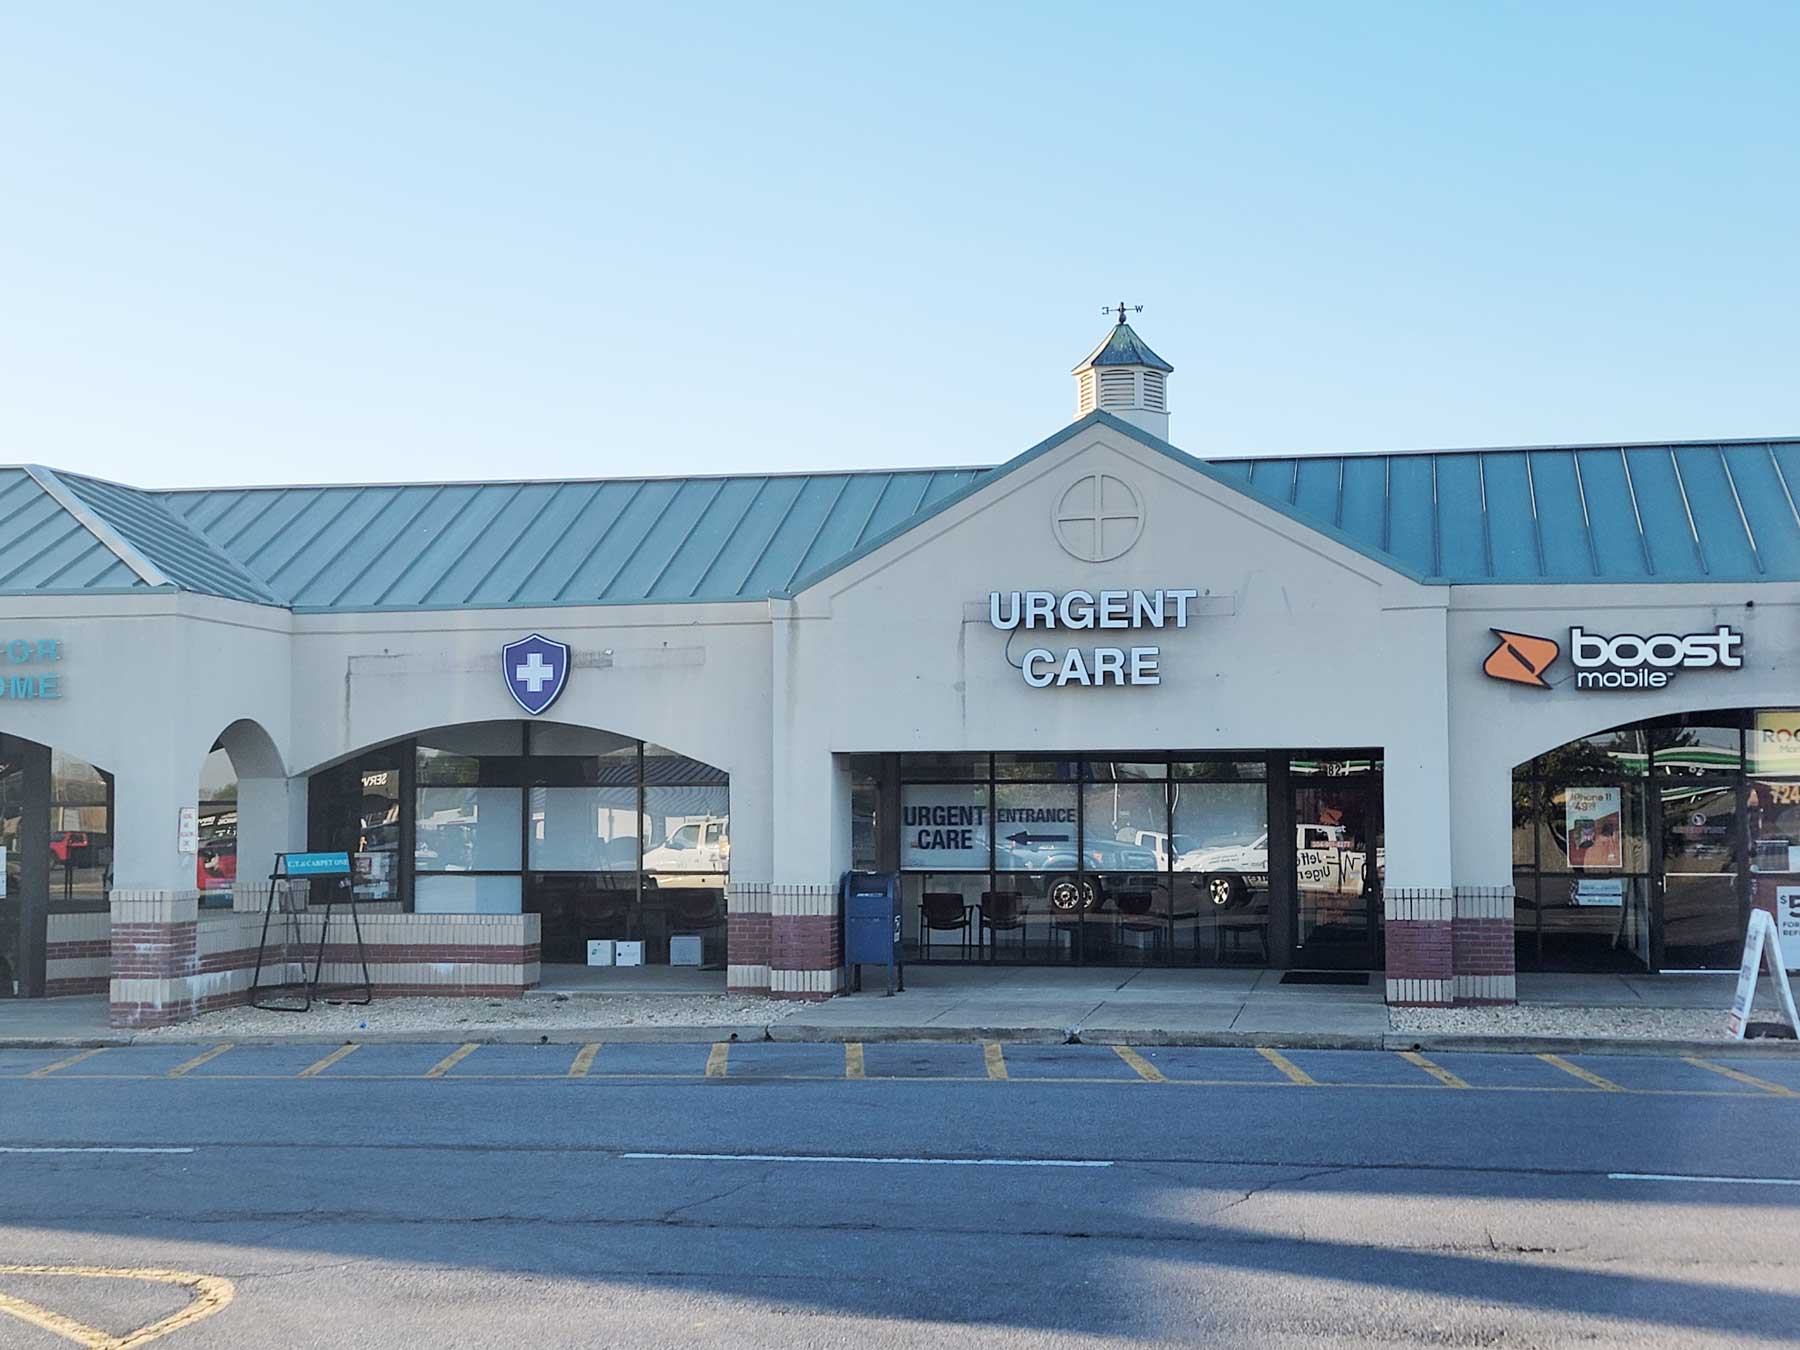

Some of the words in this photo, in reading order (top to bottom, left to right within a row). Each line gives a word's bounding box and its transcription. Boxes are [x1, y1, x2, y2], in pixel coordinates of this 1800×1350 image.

[988, 589, 1197, 630] URGENT
[1571, 627, 1742, 668] boost
[1021, 646, 1161, 688] CARE
[1577, 669, 1668, 688] mobile
[0, 674, 58, 699] ME
[903, 806, 986, 826] URGENT
[997, 808, 1076, 823] ENTRANCE
[918, 829, 973, 850] CARE
